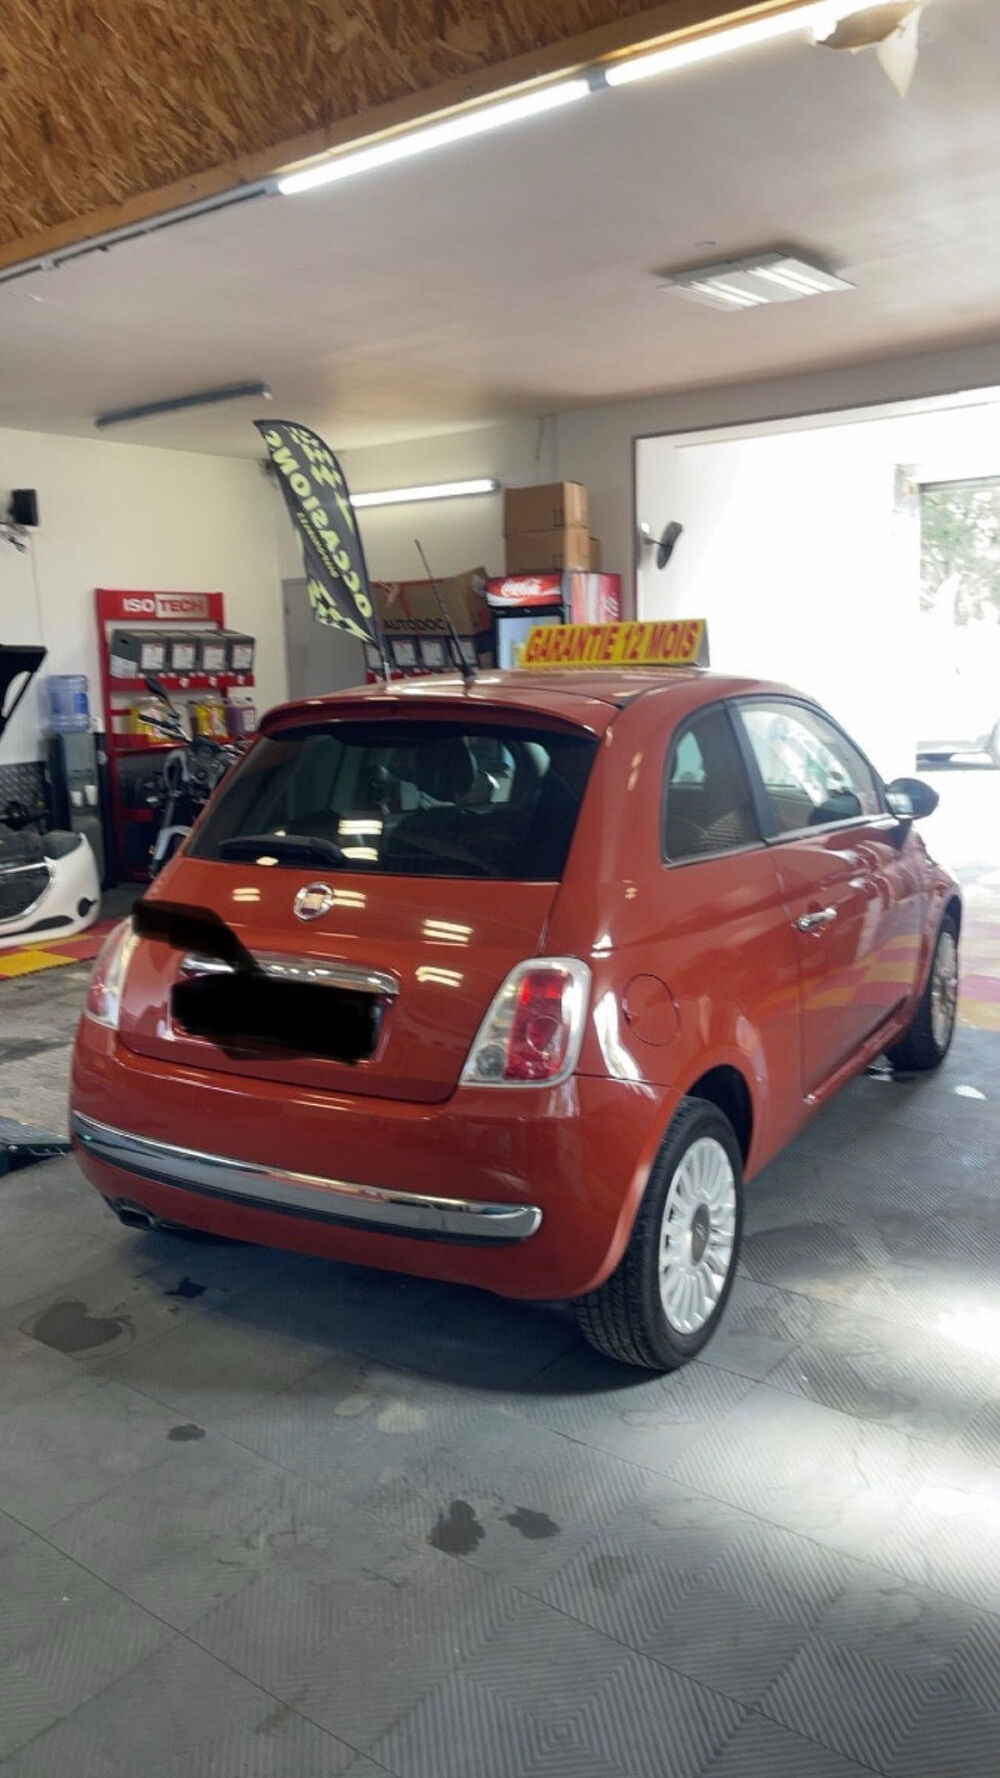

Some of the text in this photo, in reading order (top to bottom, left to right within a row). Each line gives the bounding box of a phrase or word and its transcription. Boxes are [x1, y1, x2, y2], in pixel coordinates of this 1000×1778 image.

[383, 618, 448, 631] AUTODOC
[525, 622, 698, 663] GARANTIE 12 MOIS
